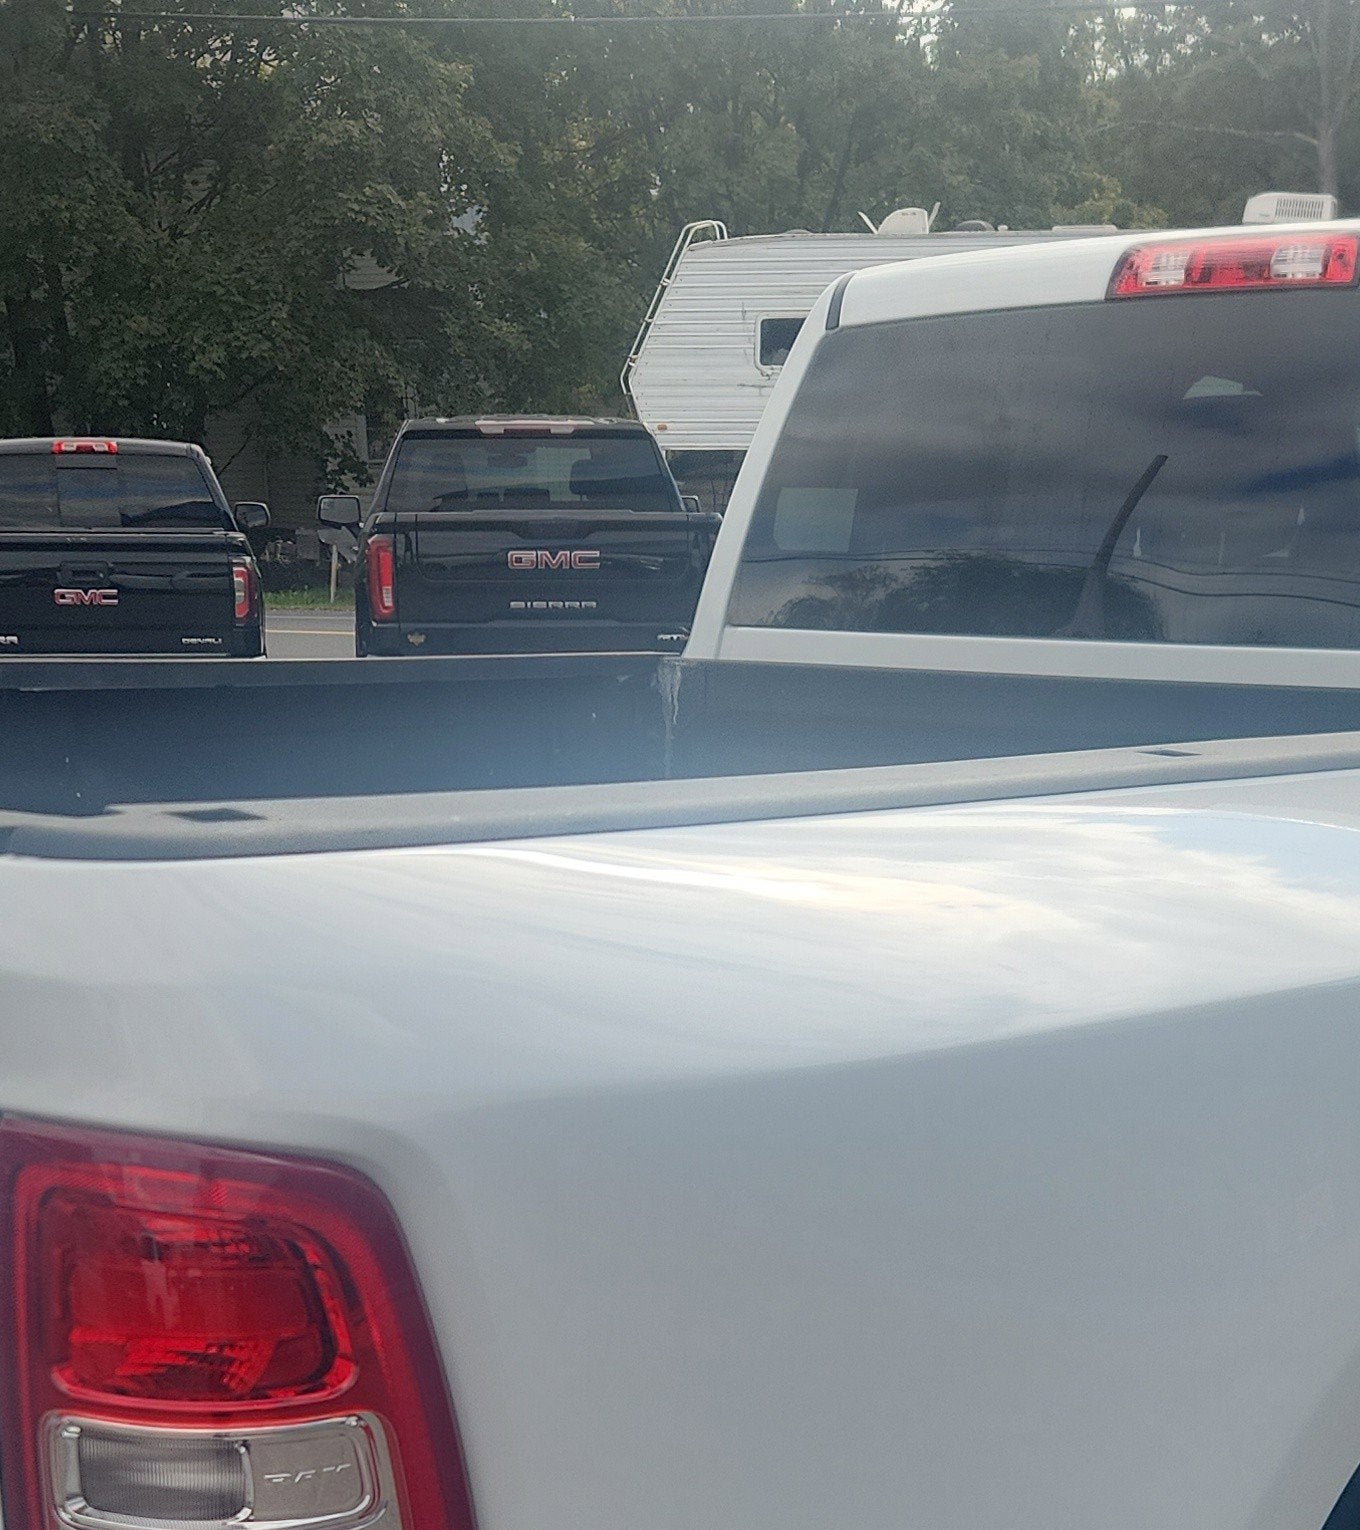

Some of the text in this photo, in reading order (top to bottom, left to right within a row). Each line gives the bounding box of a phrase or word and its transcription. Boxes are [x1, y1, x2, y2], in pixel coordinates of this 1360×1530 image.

[507, 550, 600, 570] GMC
[53, 588, 119, 606] GMC
[509, 601, 597, 609] SIERRA
